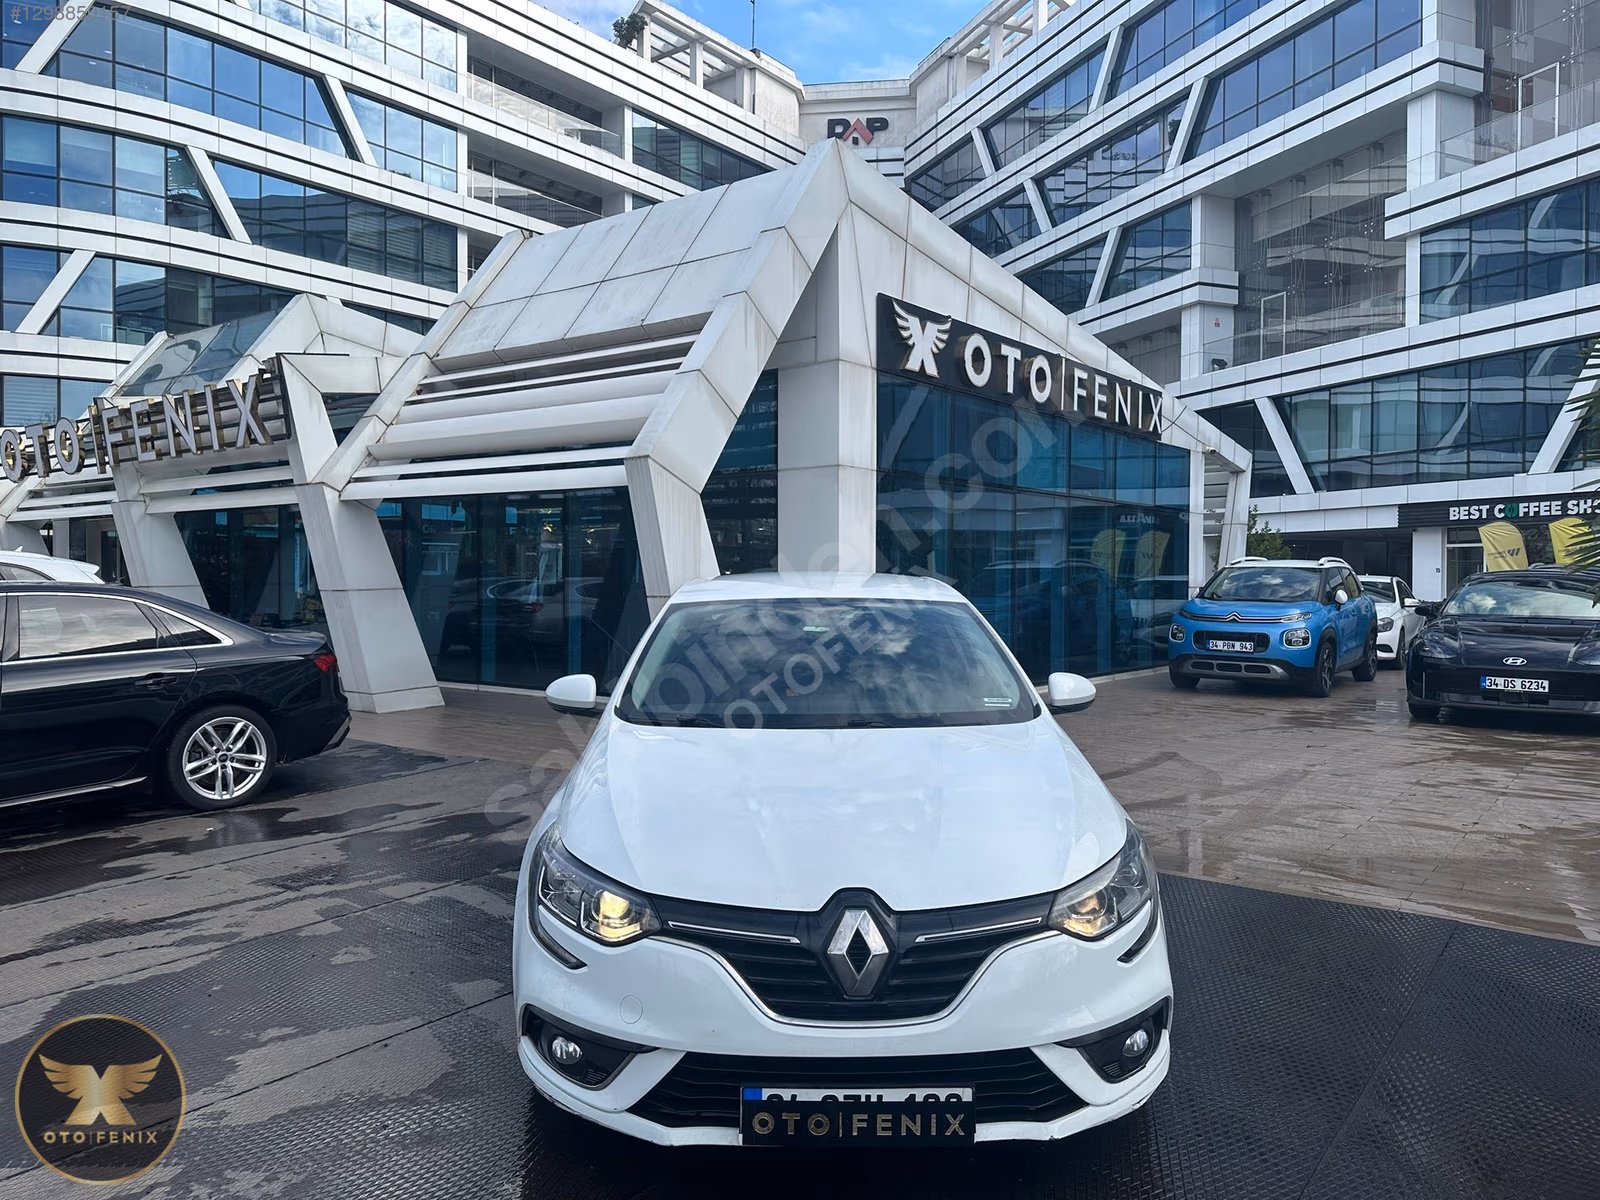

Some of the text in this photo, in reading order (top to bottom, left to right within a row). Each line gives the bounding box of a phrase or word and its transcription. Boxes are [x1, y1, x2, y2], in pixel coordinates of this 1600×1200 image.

[963, 333, 1163, 434] OTO FENIX
[0, 373, 273, 483] OTO FENIX
[1449, 505, 1490, 521] BEST
[1494, 501, 1562, 518] COFFEE
[1210, 641, 1218, 649] 34
[1239, 642, 1252, 650] 943
[1486, 677, 1546, 690] 34 DS 6234
[752, 1112, 965, 1136] OTO FENIX
